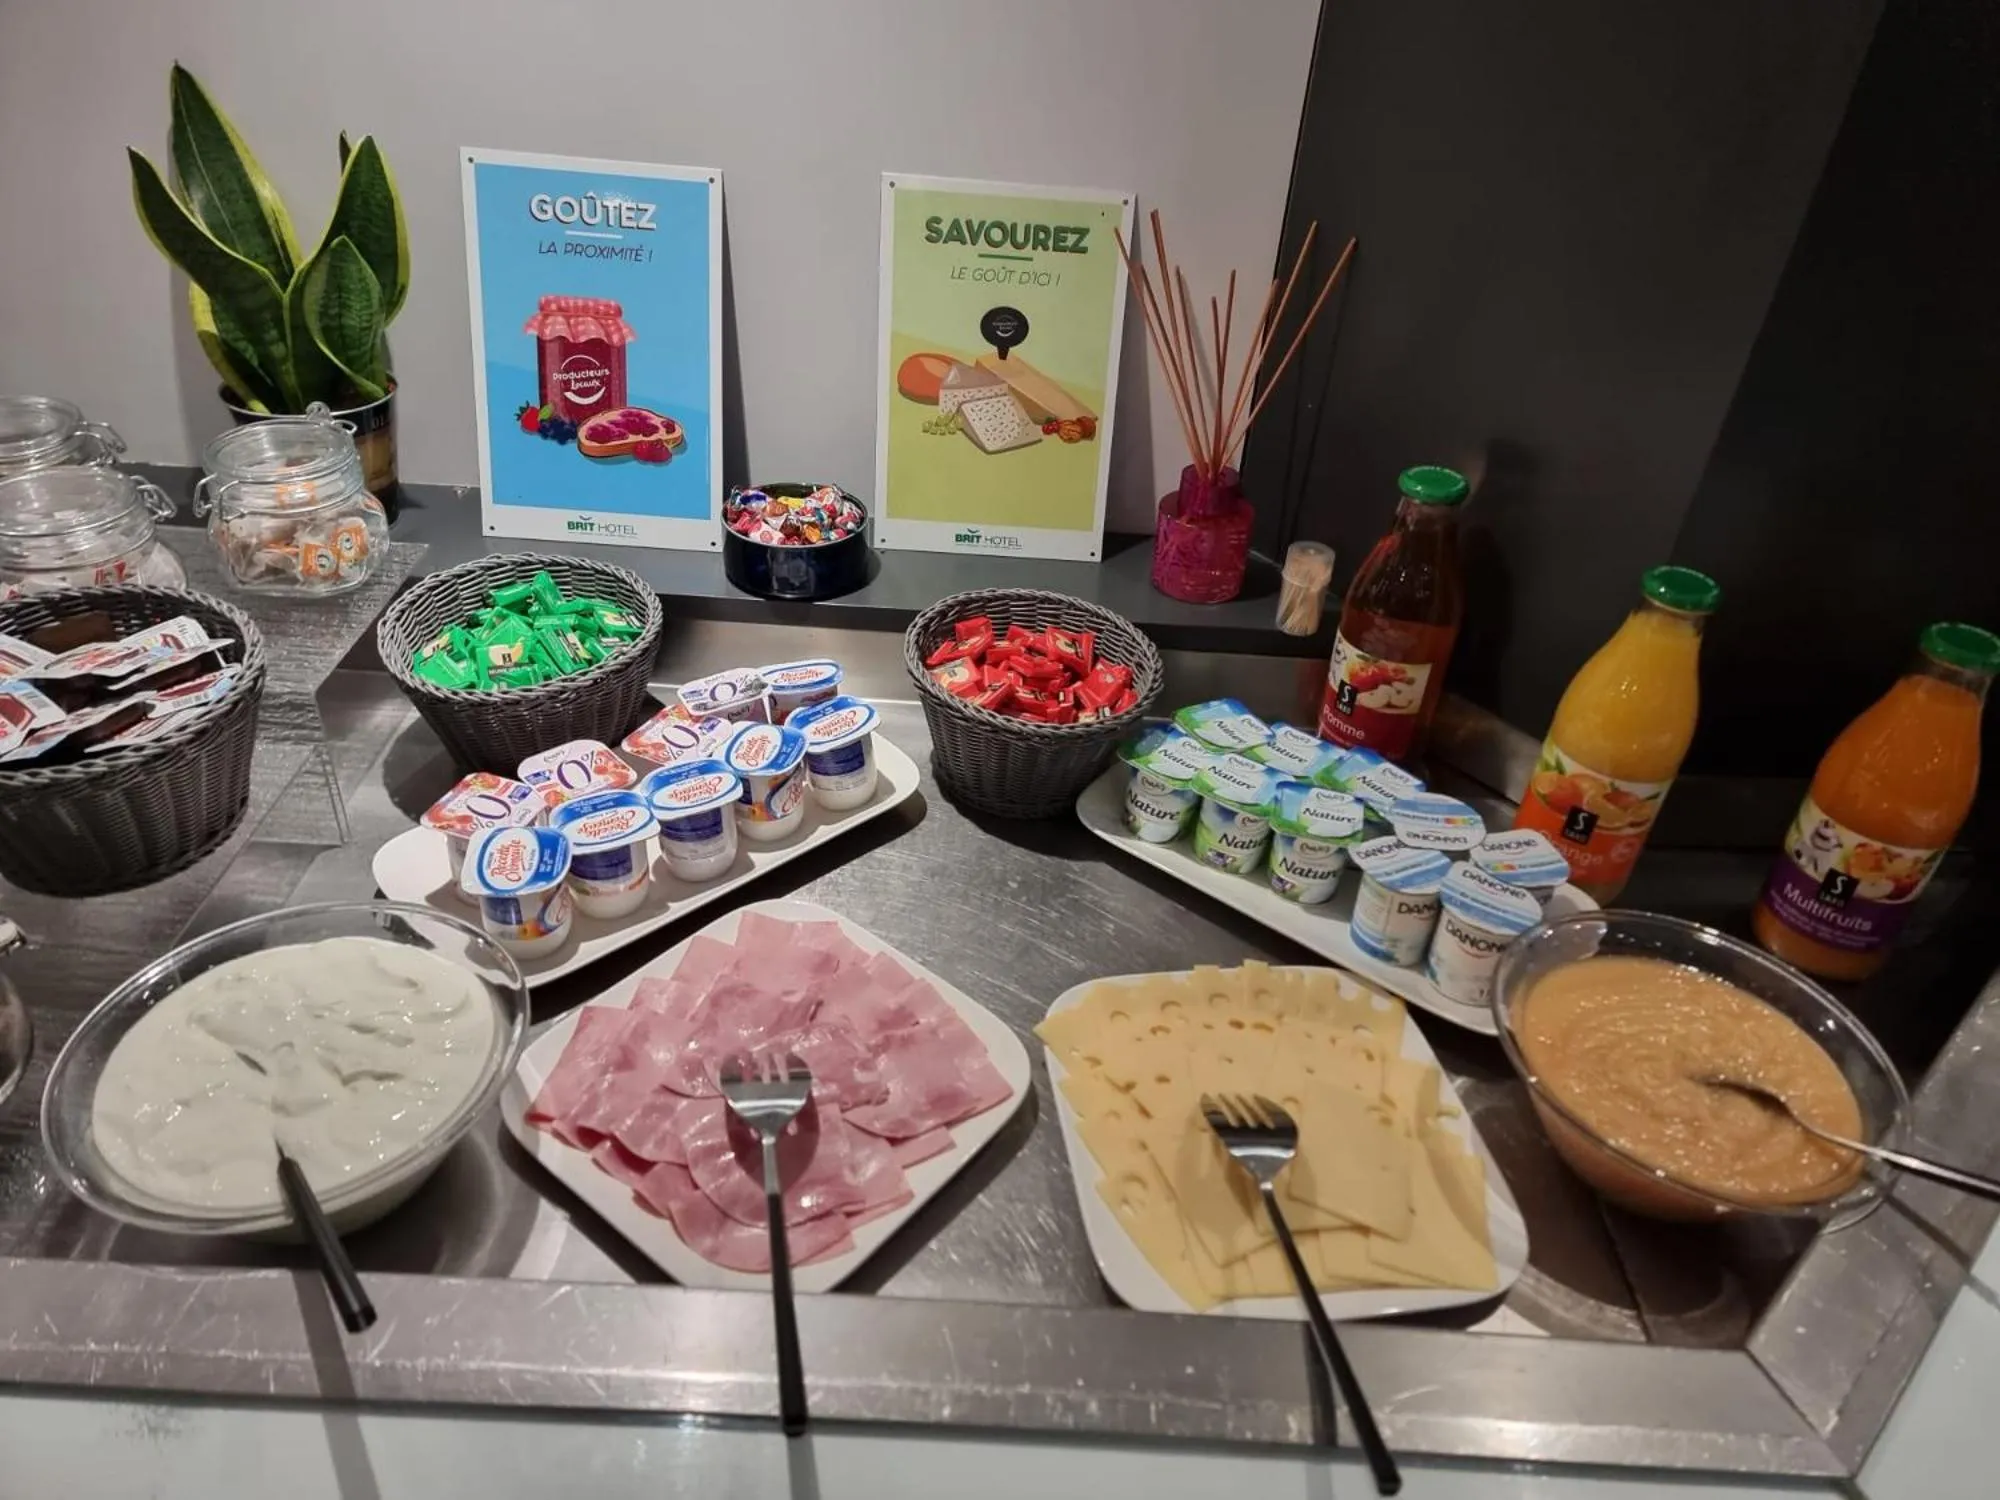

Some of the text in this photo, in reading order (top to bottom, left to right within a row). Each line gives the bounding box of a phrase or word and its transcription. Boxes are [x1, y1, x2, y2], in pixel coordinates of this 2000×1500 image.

[530, 192, 656, 230] GOÛTEZ
[924, 215, 1090, 254] SAVOUREZ
[538, 242, 558, 256] LA
[564, 242, 643, 263] PROXIMITÉ
[951, 266, 968, 280] LE
[972, 265, 1015, 284] GOÛT
[1019, 270, 1050, 287] D'ICI
[552, 368, 611, 381] Producteurs
[567, 518, 595, 532] BRIT
[598, 523, 638, 536] HOTEL
[954, 531, 1022, 547] BRIT HOTEL
[1324, 703, 1366, 740] Pomme
[1302, 807, 1356, 822] Nature
[1482, 838, 1538, 851] DANONE
[1462, 869, 1526, 899] DANONE
[1783, 881, 1872, 932] Multifruits
